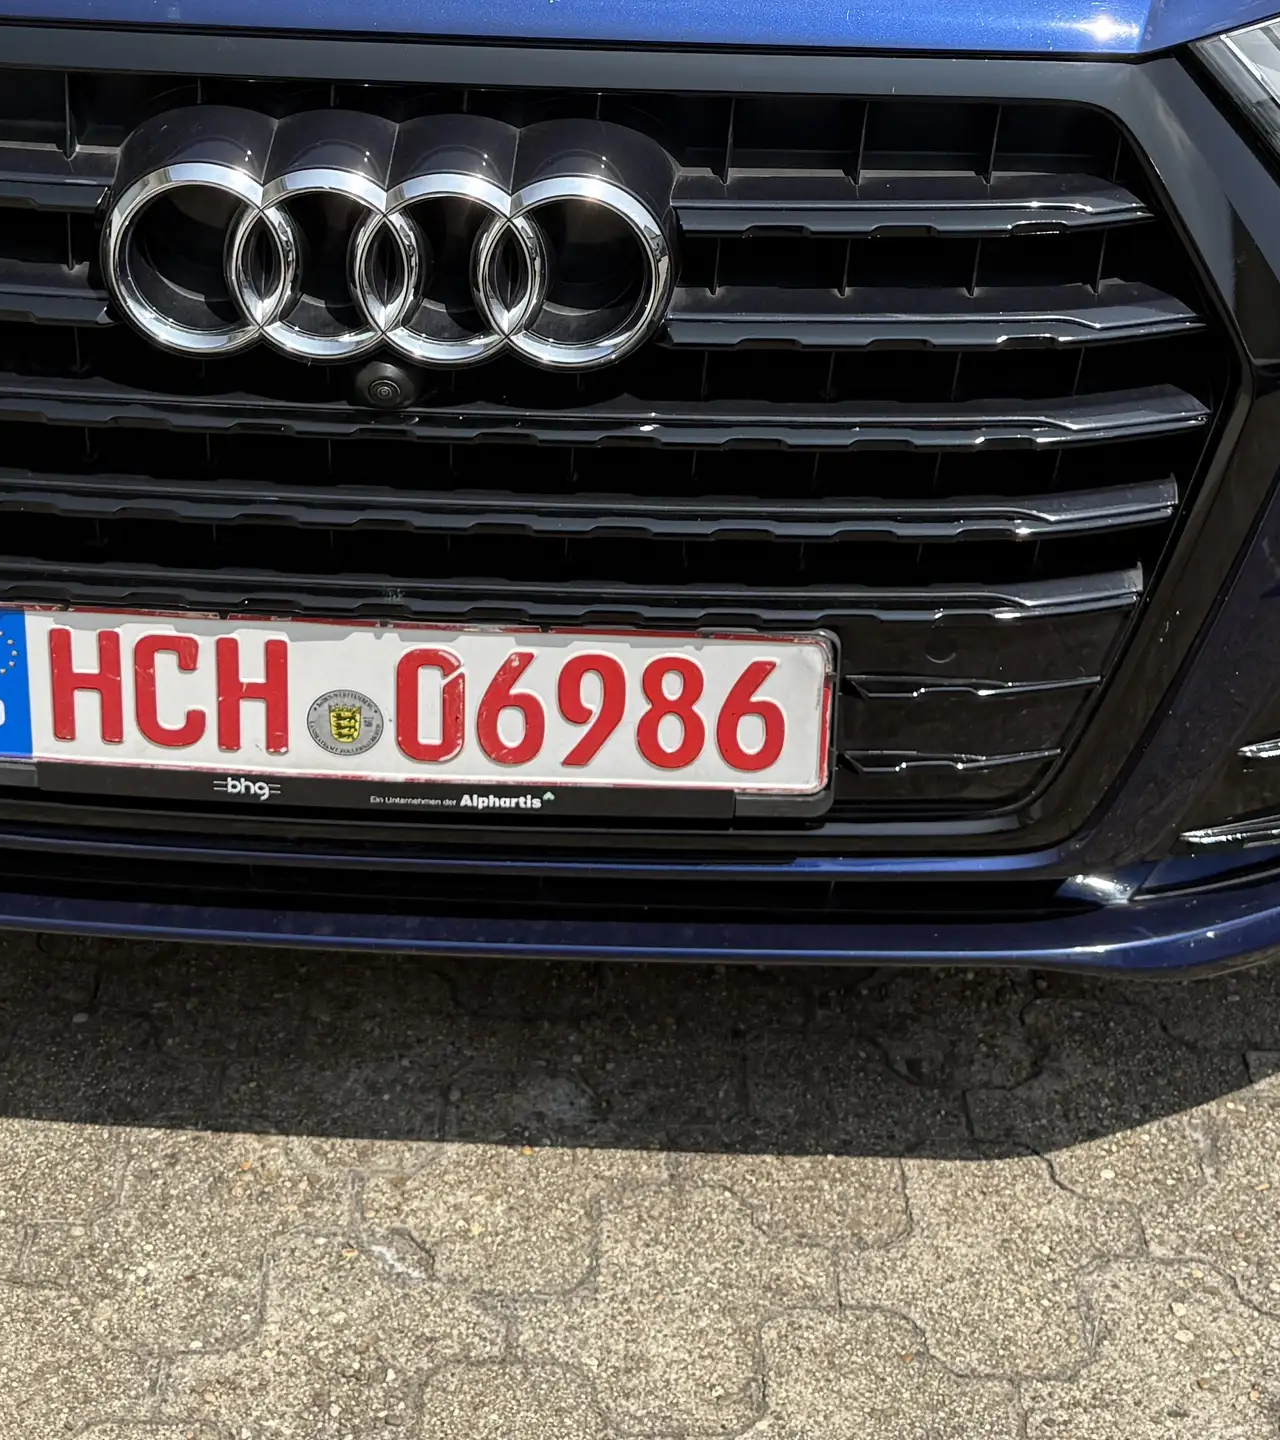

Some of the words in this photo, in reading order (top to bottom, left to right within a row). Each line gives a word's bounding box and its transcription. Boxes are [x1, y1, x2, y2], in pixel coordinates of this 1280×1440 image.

[48, 627, 289, 755] HCH
[395, 647, 786, 772] 06986
[226, 776, 271, 801] bhg
[369, 795, 384, 804] Ein
[385, 796, 442, 806] Unternehmen
[443, 798, 457, 807] der
[459, 793, 542, 811] Alphartis
